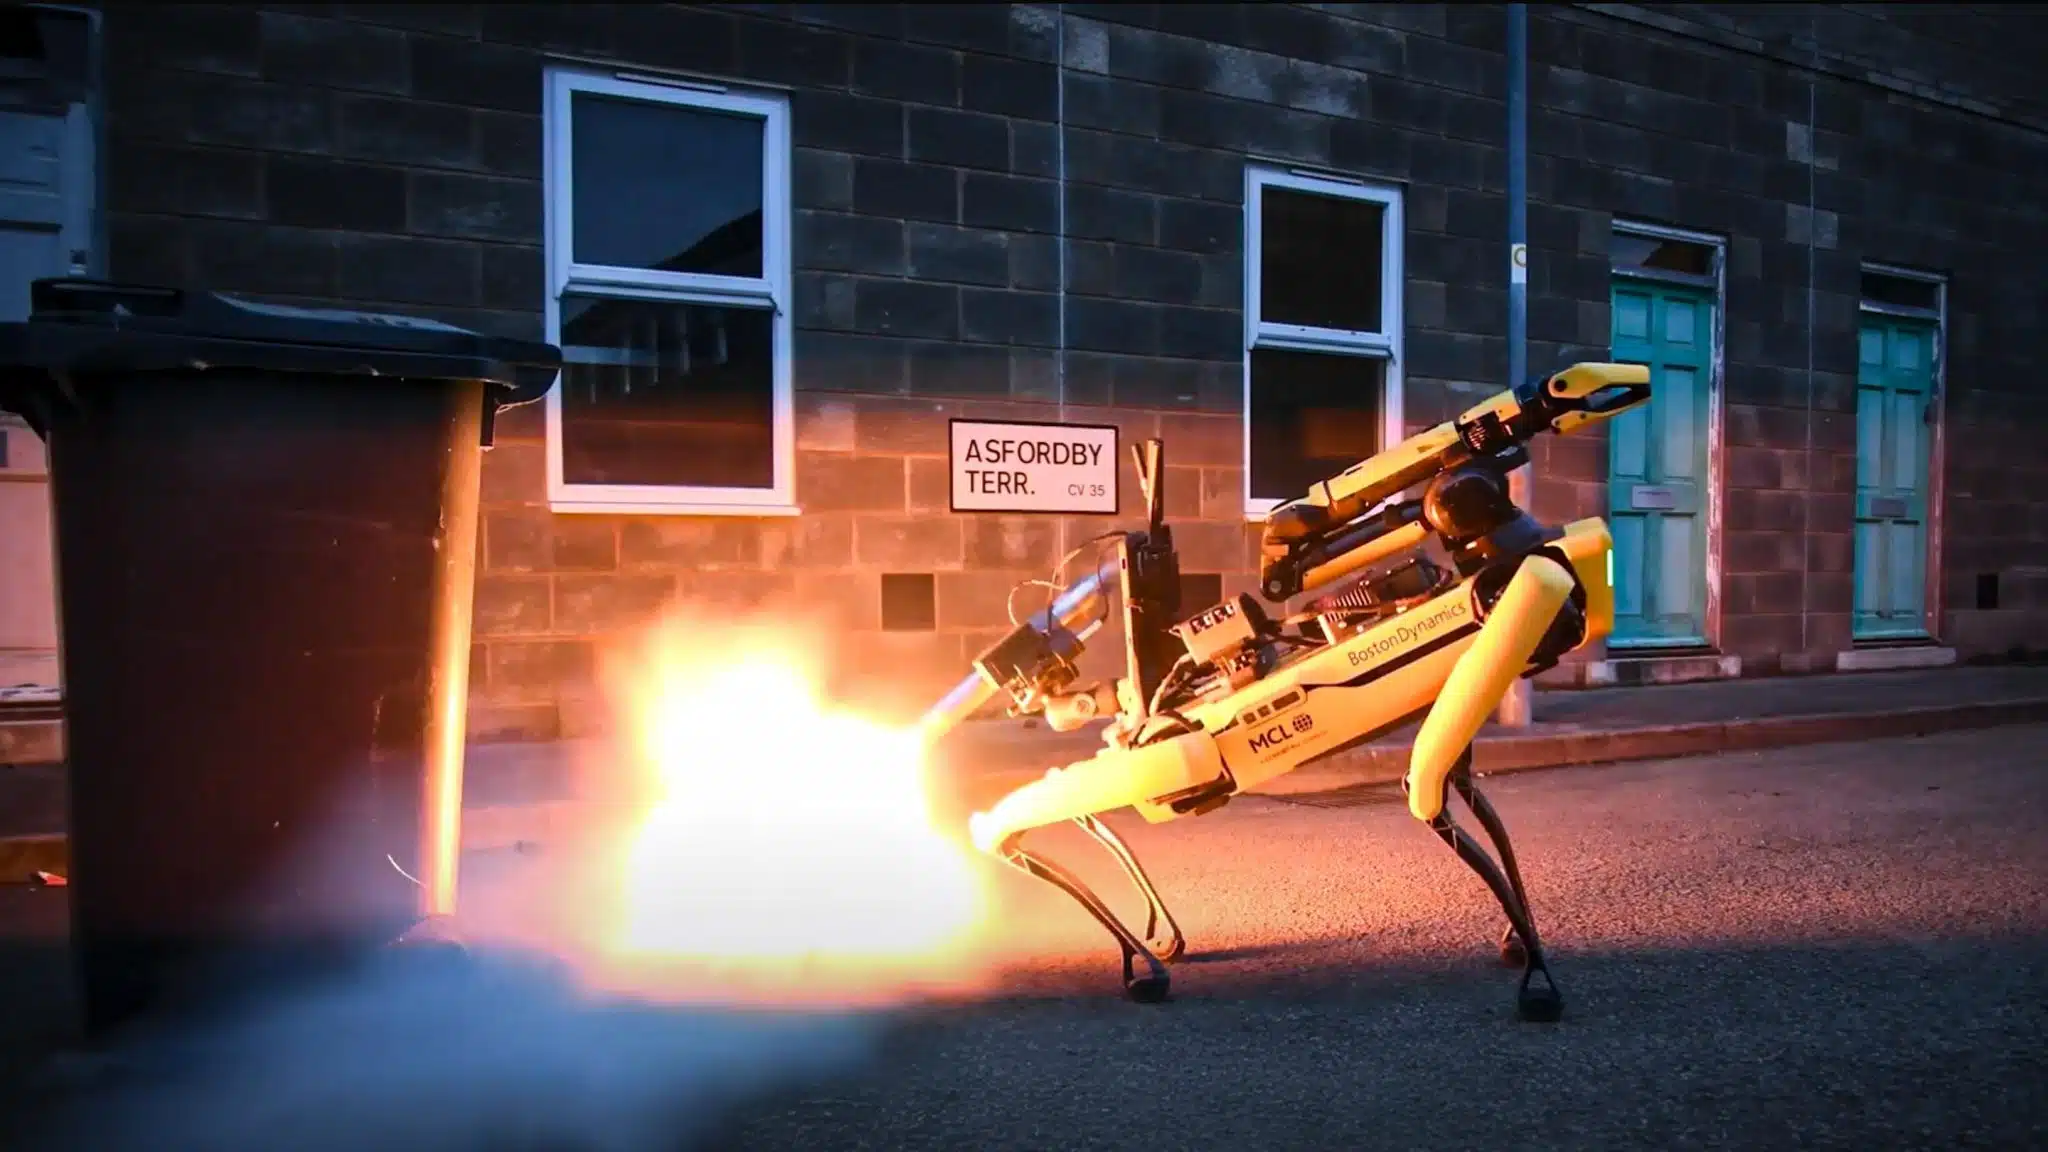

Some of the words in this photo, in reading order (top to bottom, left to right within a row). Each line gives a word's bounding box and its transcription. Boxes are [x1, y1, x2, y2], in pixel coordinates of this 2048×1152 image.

[965, 439, 1103, 466] ASFORDBY
[965, 470, 1036, 495] TERR.
[1067, 484, 1085, 496] CV
[1089, 484, 1105, 497] 35
[1247, 724, 1293, 754] MCL
